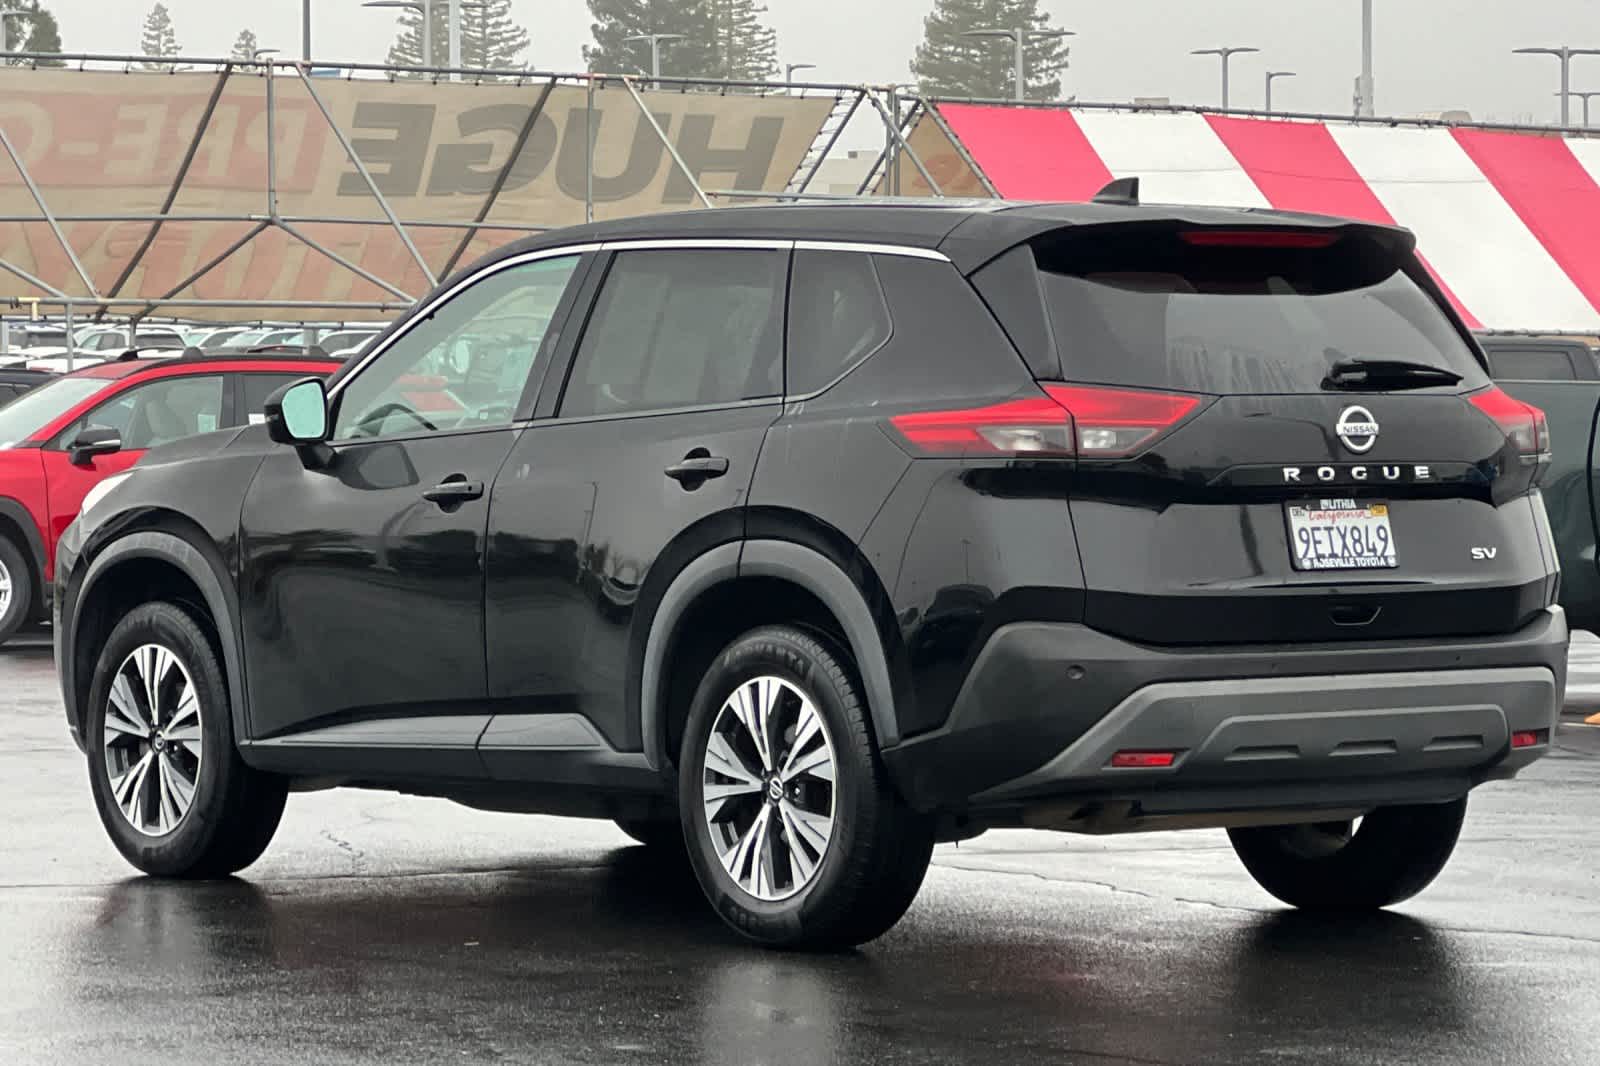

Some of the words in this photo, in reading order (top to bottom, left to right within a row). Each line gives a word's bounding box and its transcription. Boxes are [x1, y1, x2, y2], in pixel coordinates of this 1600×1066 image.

[1343, 423, 1377, 433] NISSAN
[1282, 465, 1430, 482] ROGUE
[1328, 498, 1357, 509] LITHIA
[1309, 510, 1366, 523] California
[1472, 547, 1497, 559] SV
[1313, 557, 1355, 568] ROSEVILLE
[1357, 556, 1386, 567] TOYOTA
